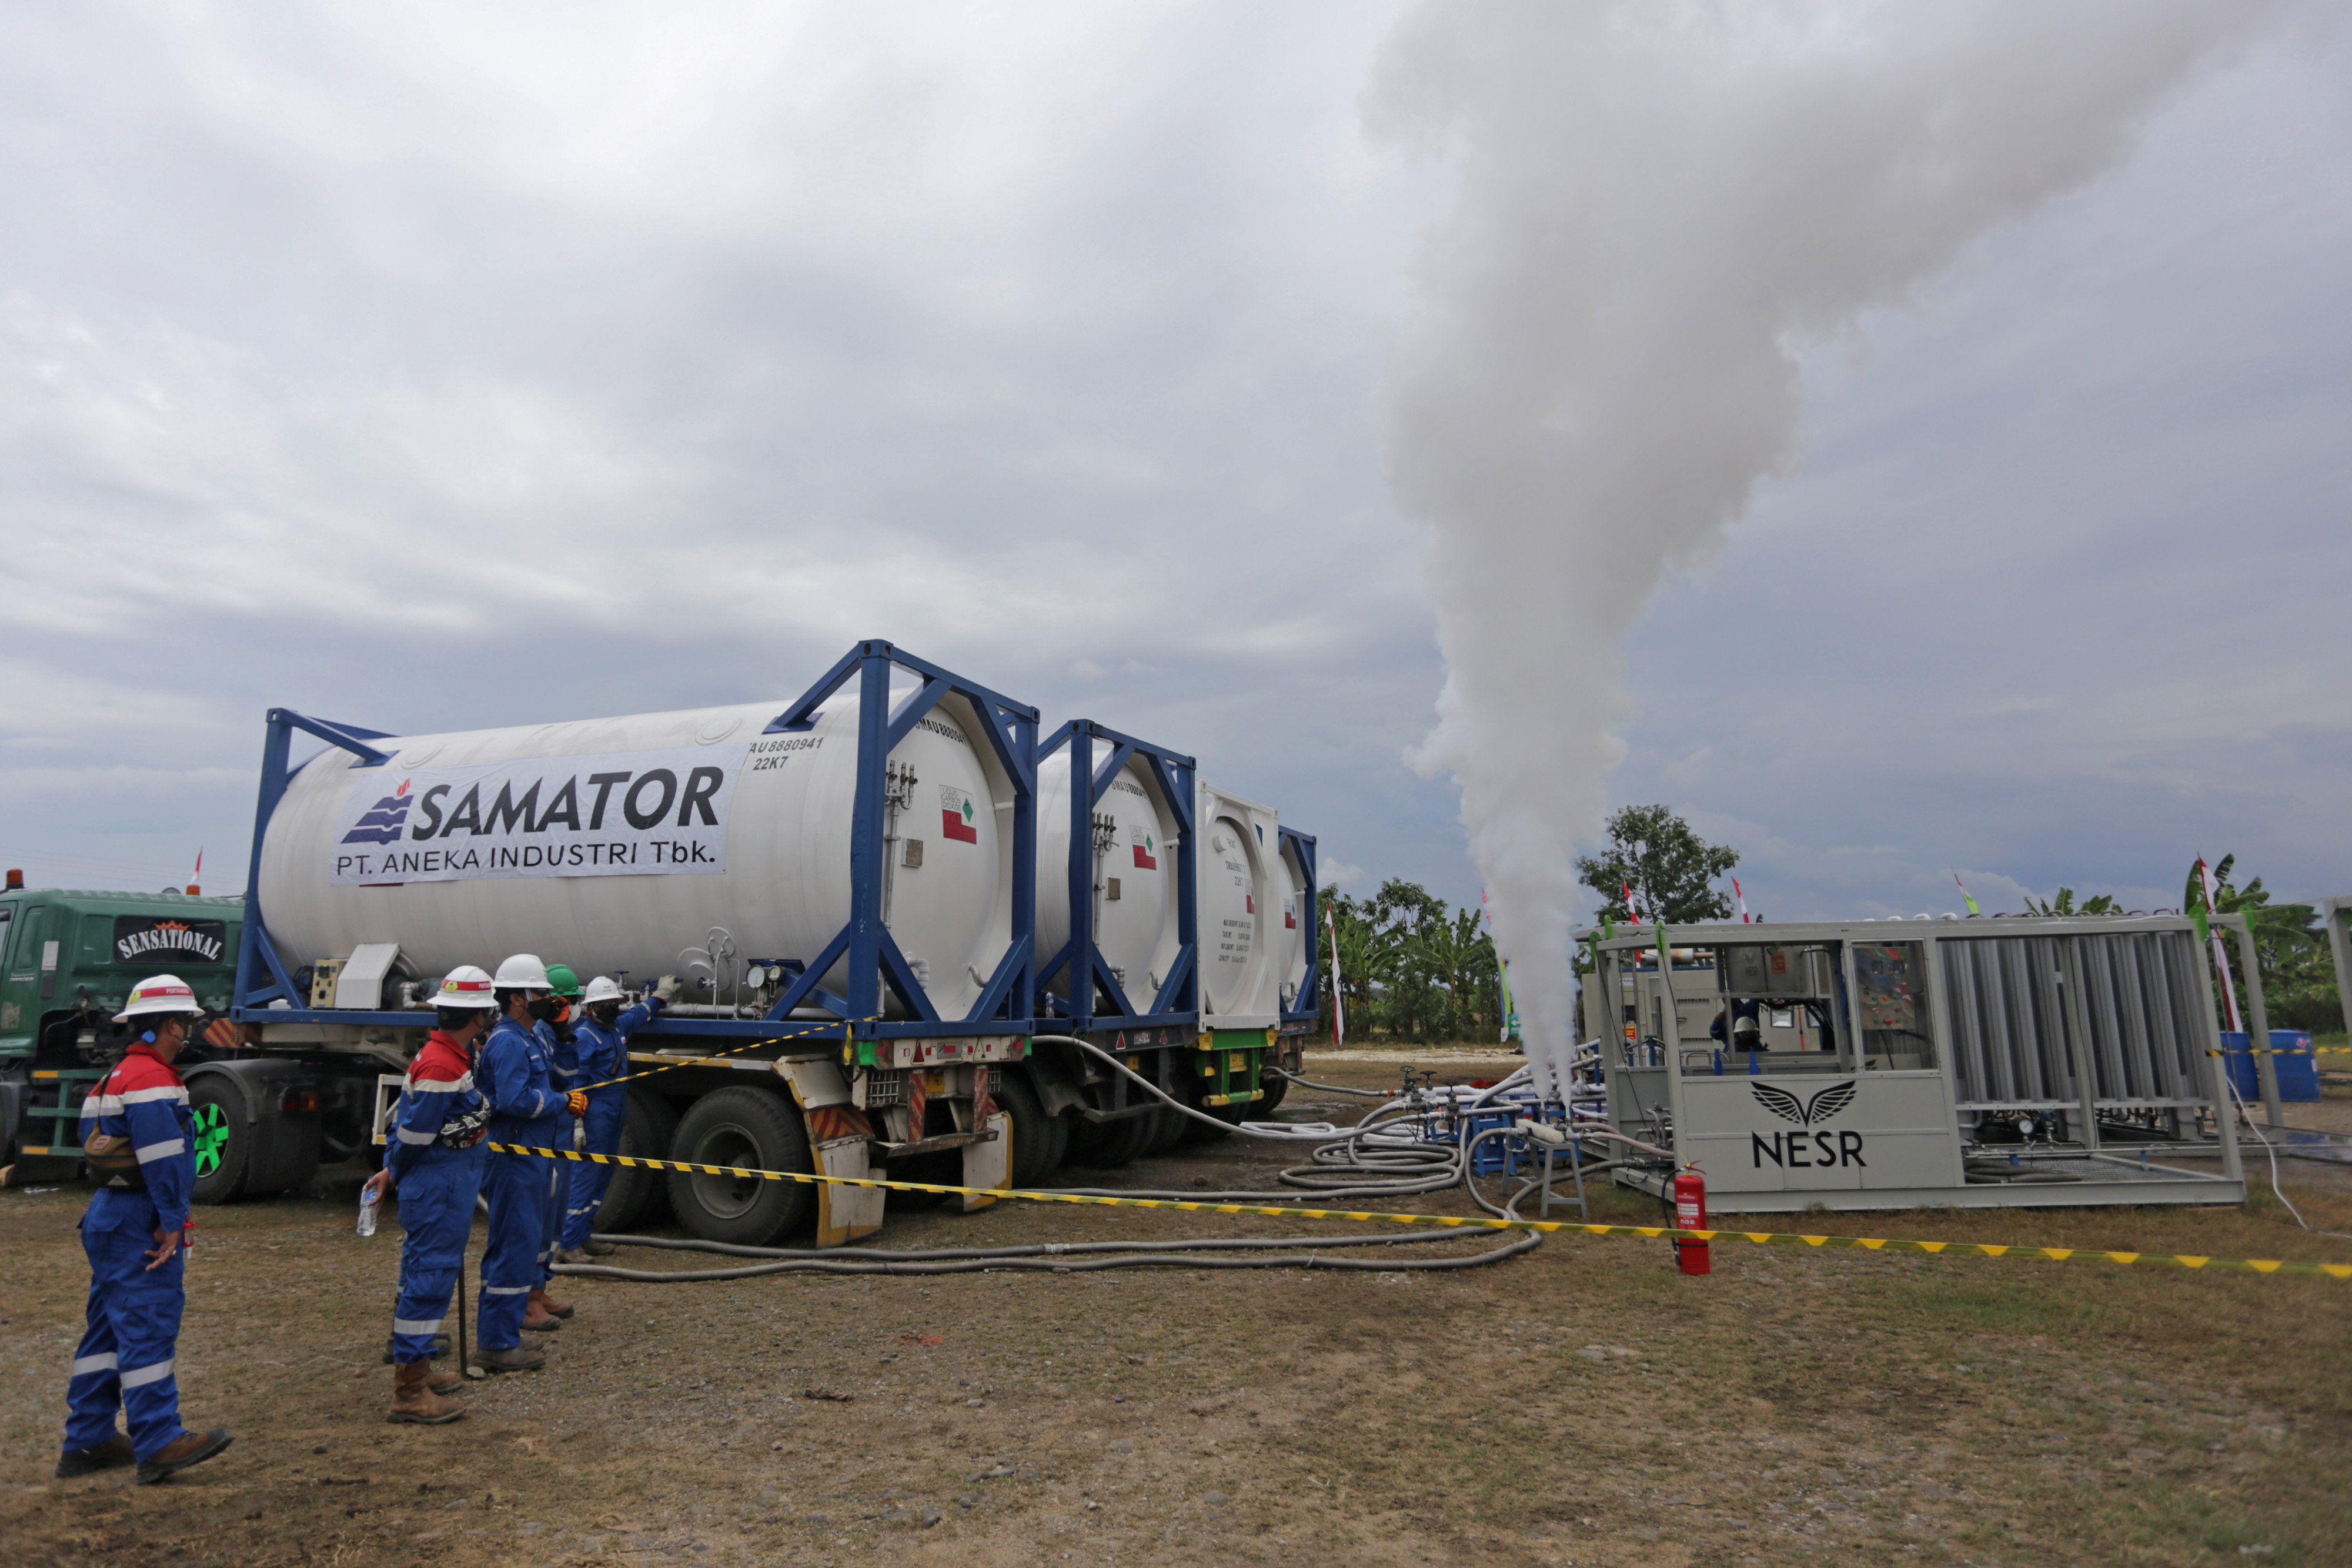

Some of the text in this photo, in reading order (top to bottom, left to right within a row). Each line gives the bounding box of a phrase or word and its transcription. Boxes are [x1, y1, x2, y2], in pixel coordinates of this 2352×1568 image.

[749, 737, 824, 754] AU8880941
[753, 756, 789, 771] 22K7
[412, 766, 724, 841] SAMATOR
[941, 794, 961, 804] CARBON
[337, 841, 715, 875] PT. ANEKA INDUSTRI Tbk.
[118, 929, 222, 960] SENSATIONAL
[443, 1123, 460, 1132] NIKE
[1752, 1131, 1867, 1168] NESR
